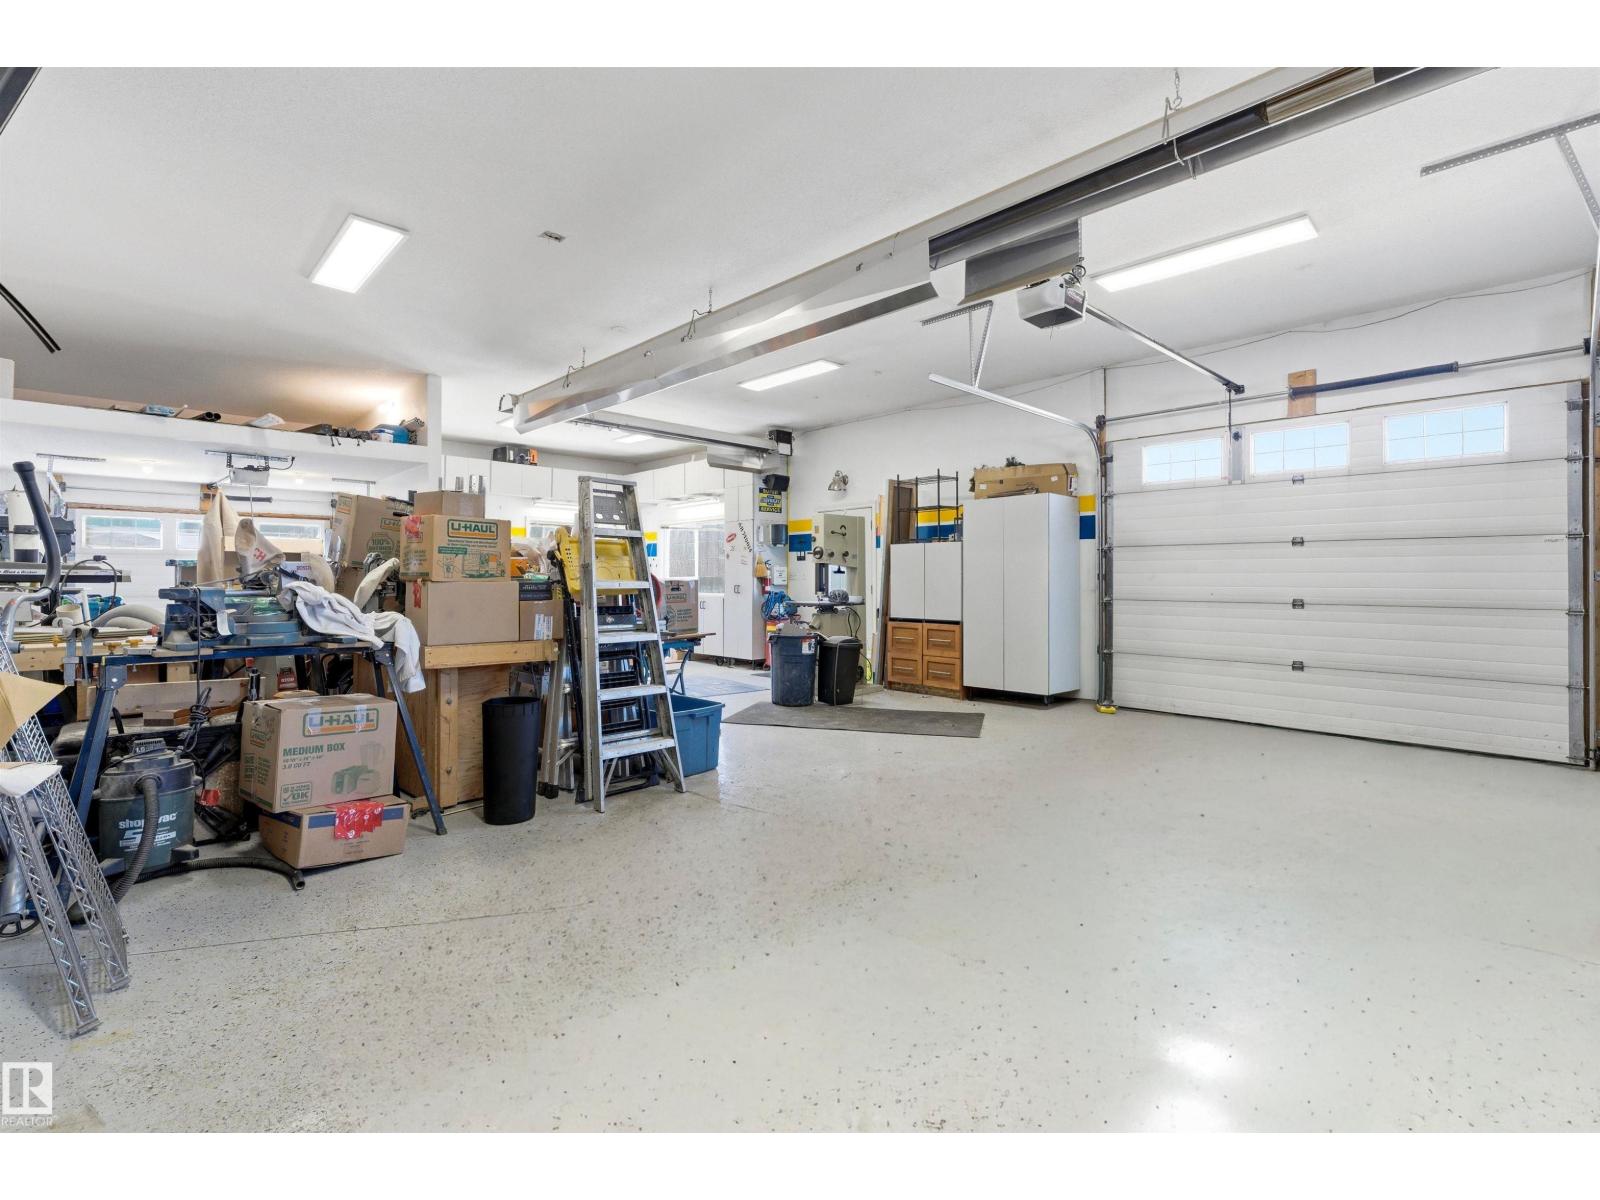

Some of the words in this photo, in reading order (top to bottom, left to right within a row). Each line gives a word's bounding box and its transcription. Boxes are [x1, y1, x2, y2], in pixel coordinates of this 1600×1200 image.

[450, 522, 496, 534] U-HAUL
[308, 712, 375, 728] U-HAUL
[282, 744, 324, 757] MEDIUM
[327, 742, 346, 752] BOX
